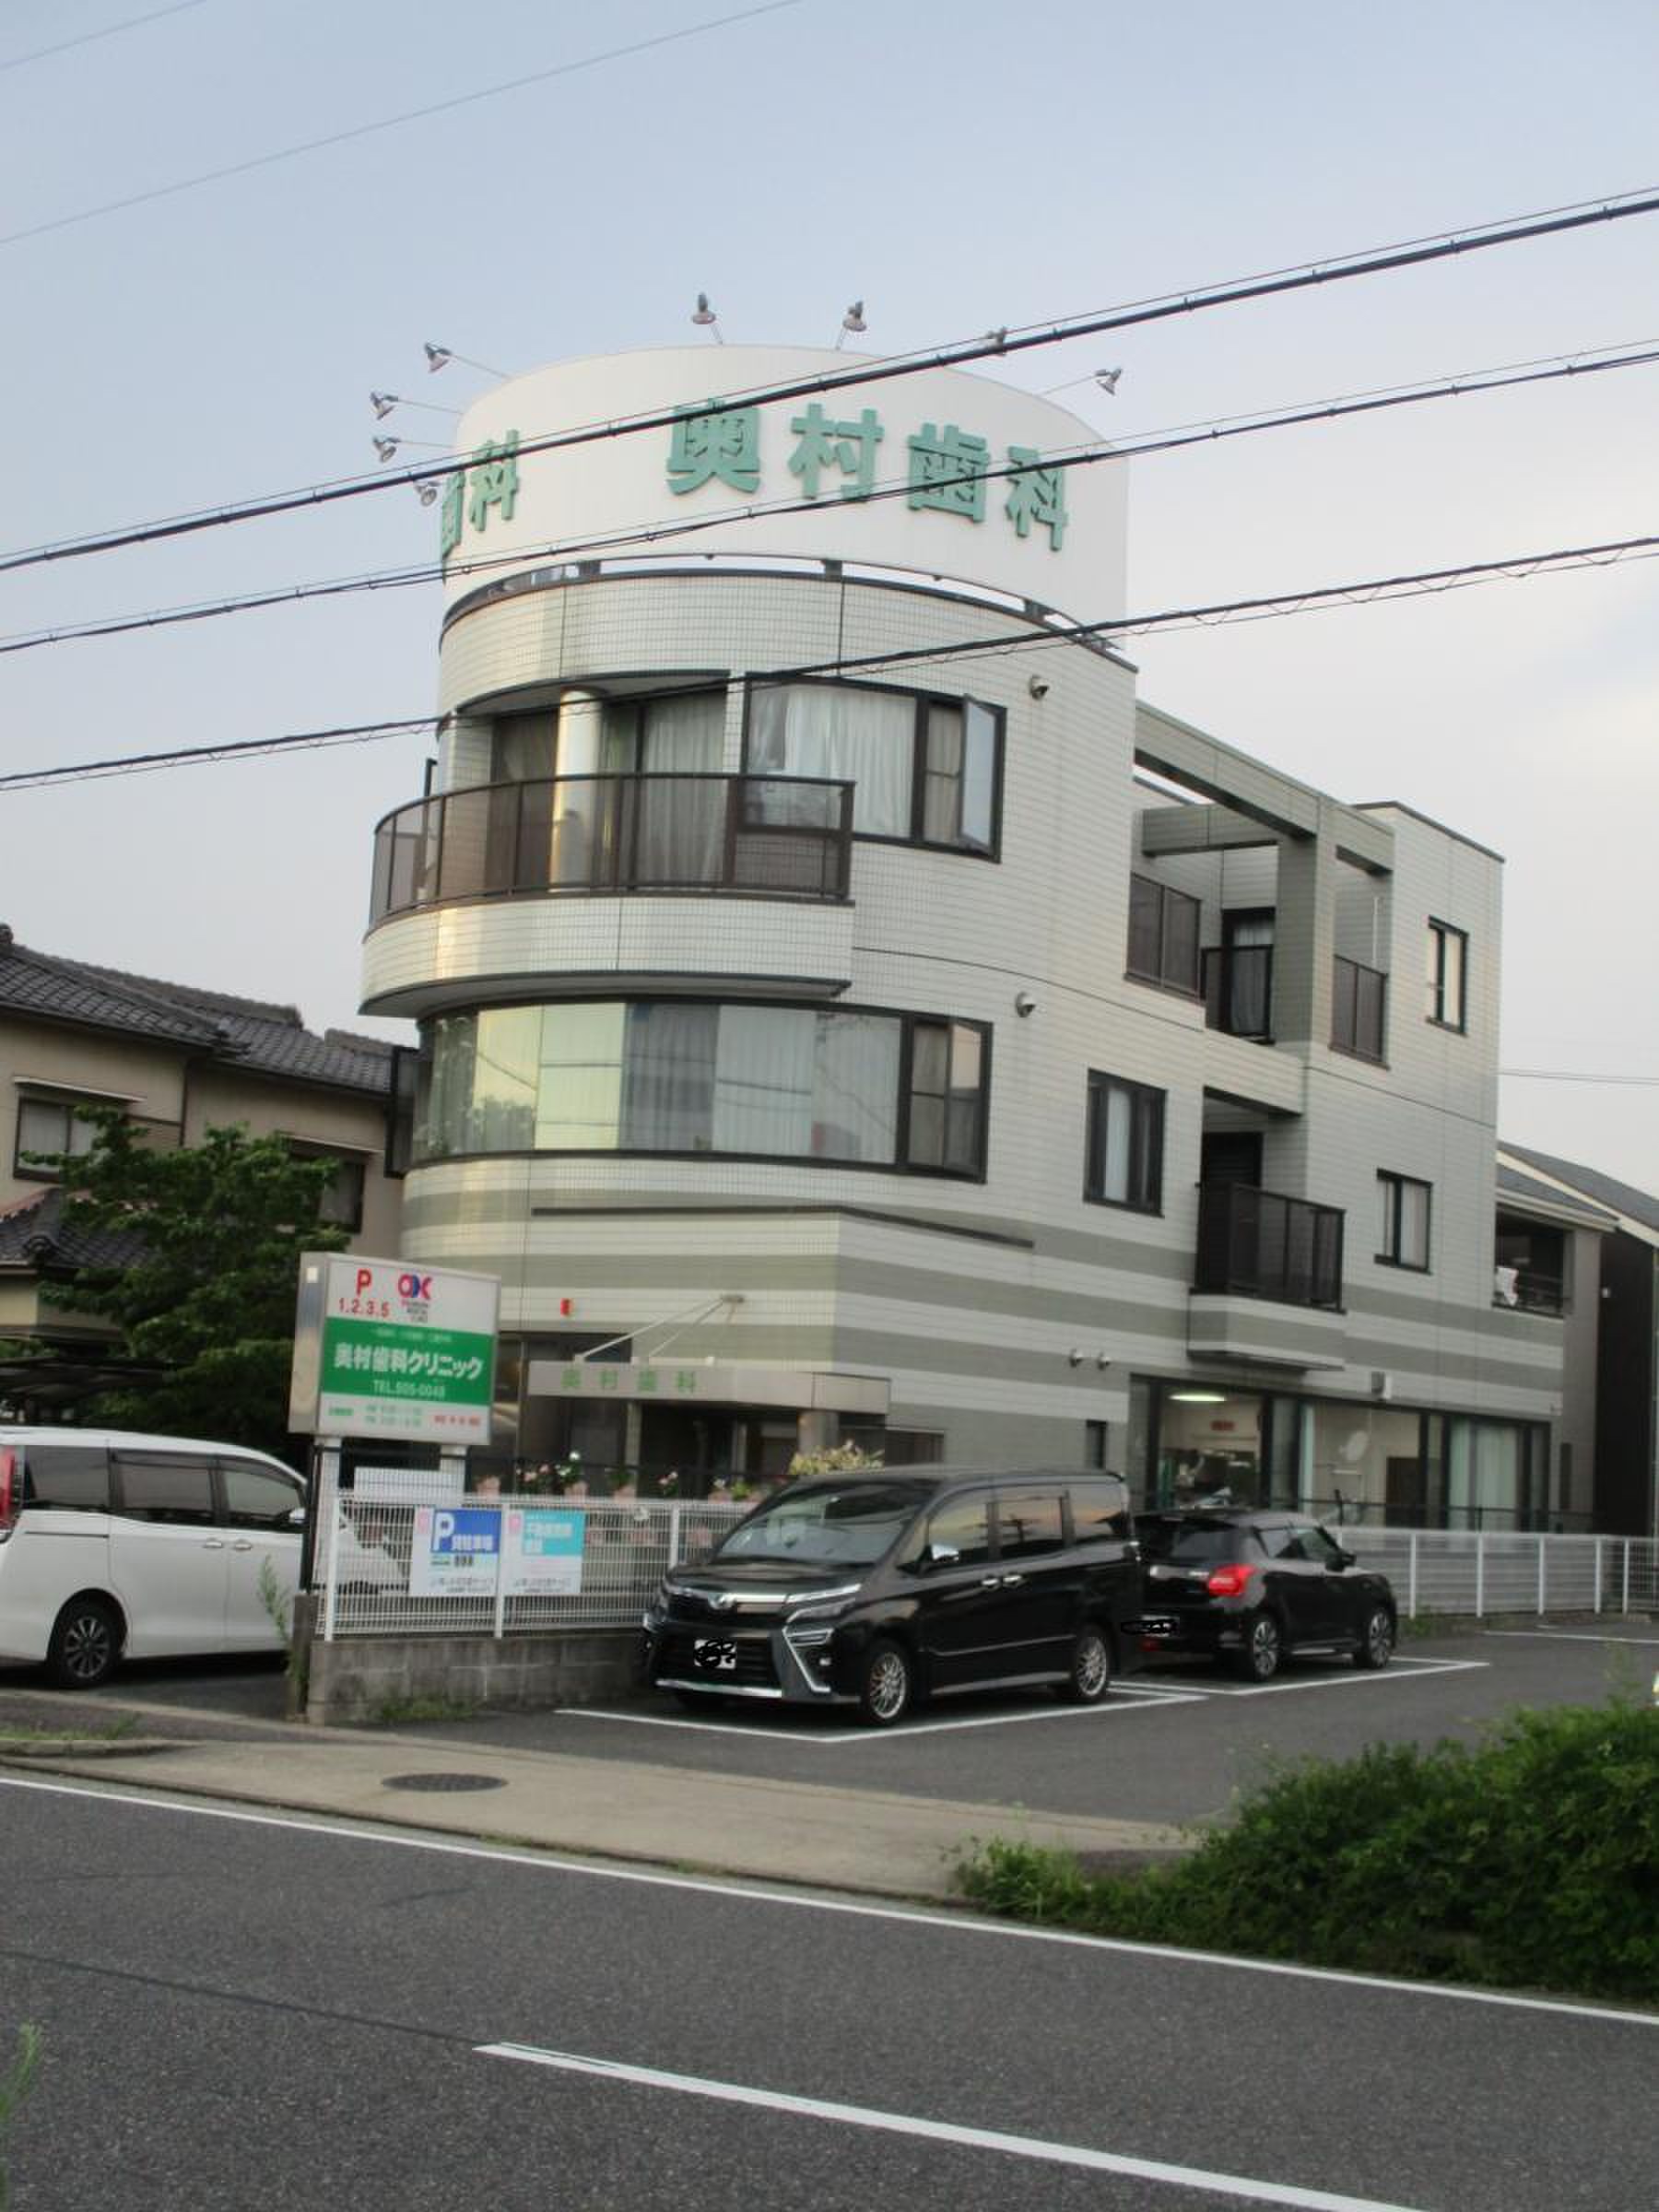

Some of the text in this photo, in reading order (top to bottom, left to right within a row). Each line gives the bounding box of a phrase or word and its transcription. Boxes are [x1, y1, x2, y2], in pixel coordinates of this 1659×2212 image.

[665, 398, 1069, 551] 奥村歯科
[356, 1267, 372, 1297] P
[333, 1342, 484, 1381] 奥村歯科クリニック
[432, 1512, 455, 1551] P
